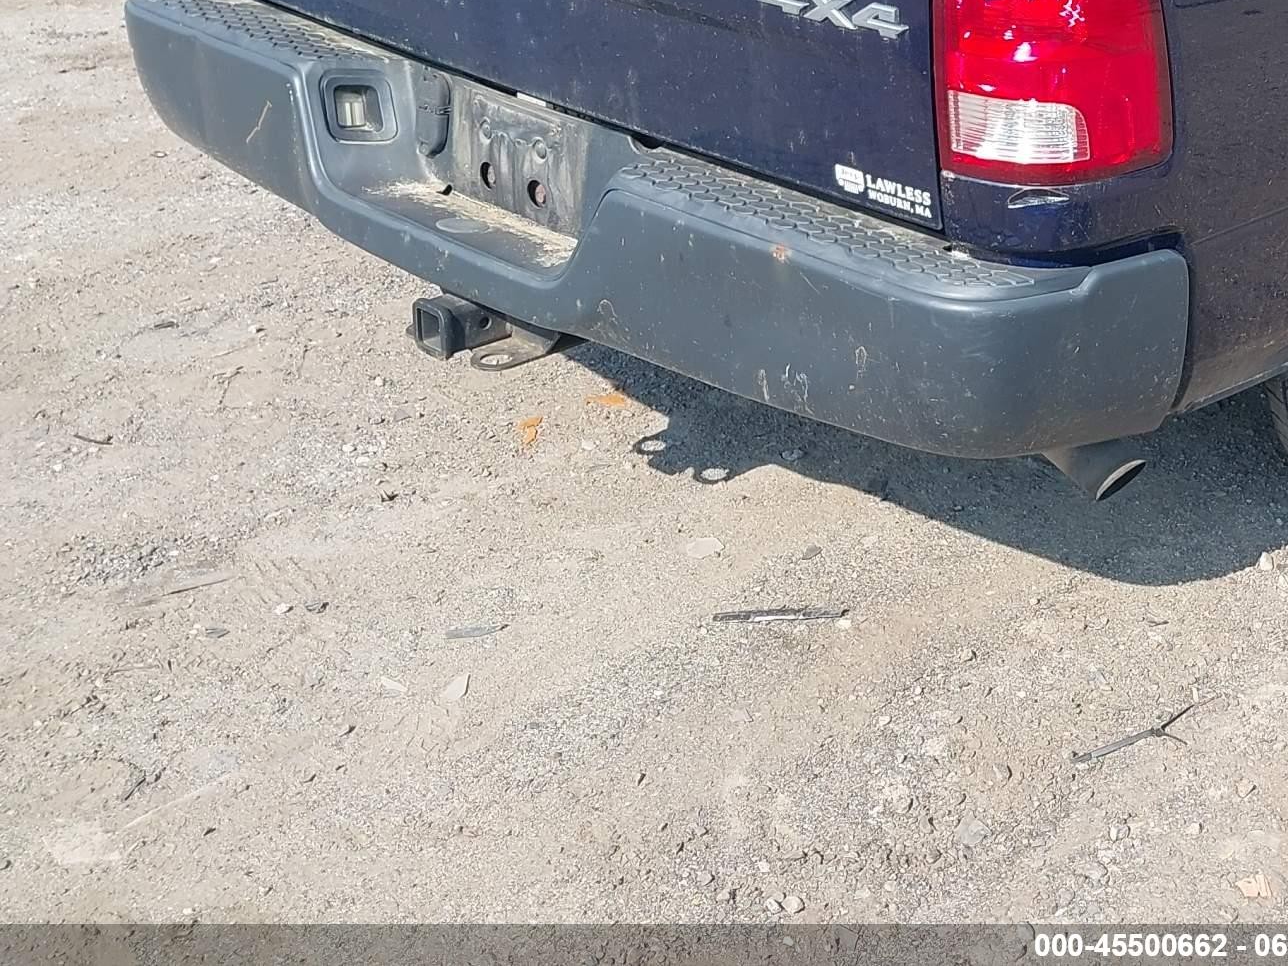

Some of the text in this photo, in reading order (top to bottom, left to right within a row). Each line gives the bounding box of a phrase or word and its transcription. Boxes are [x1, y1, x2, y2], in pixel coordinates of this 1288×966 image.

[865, 173, 932, 206] LAWLESS
[867, 189, 933, 219] WOBURN, MA
